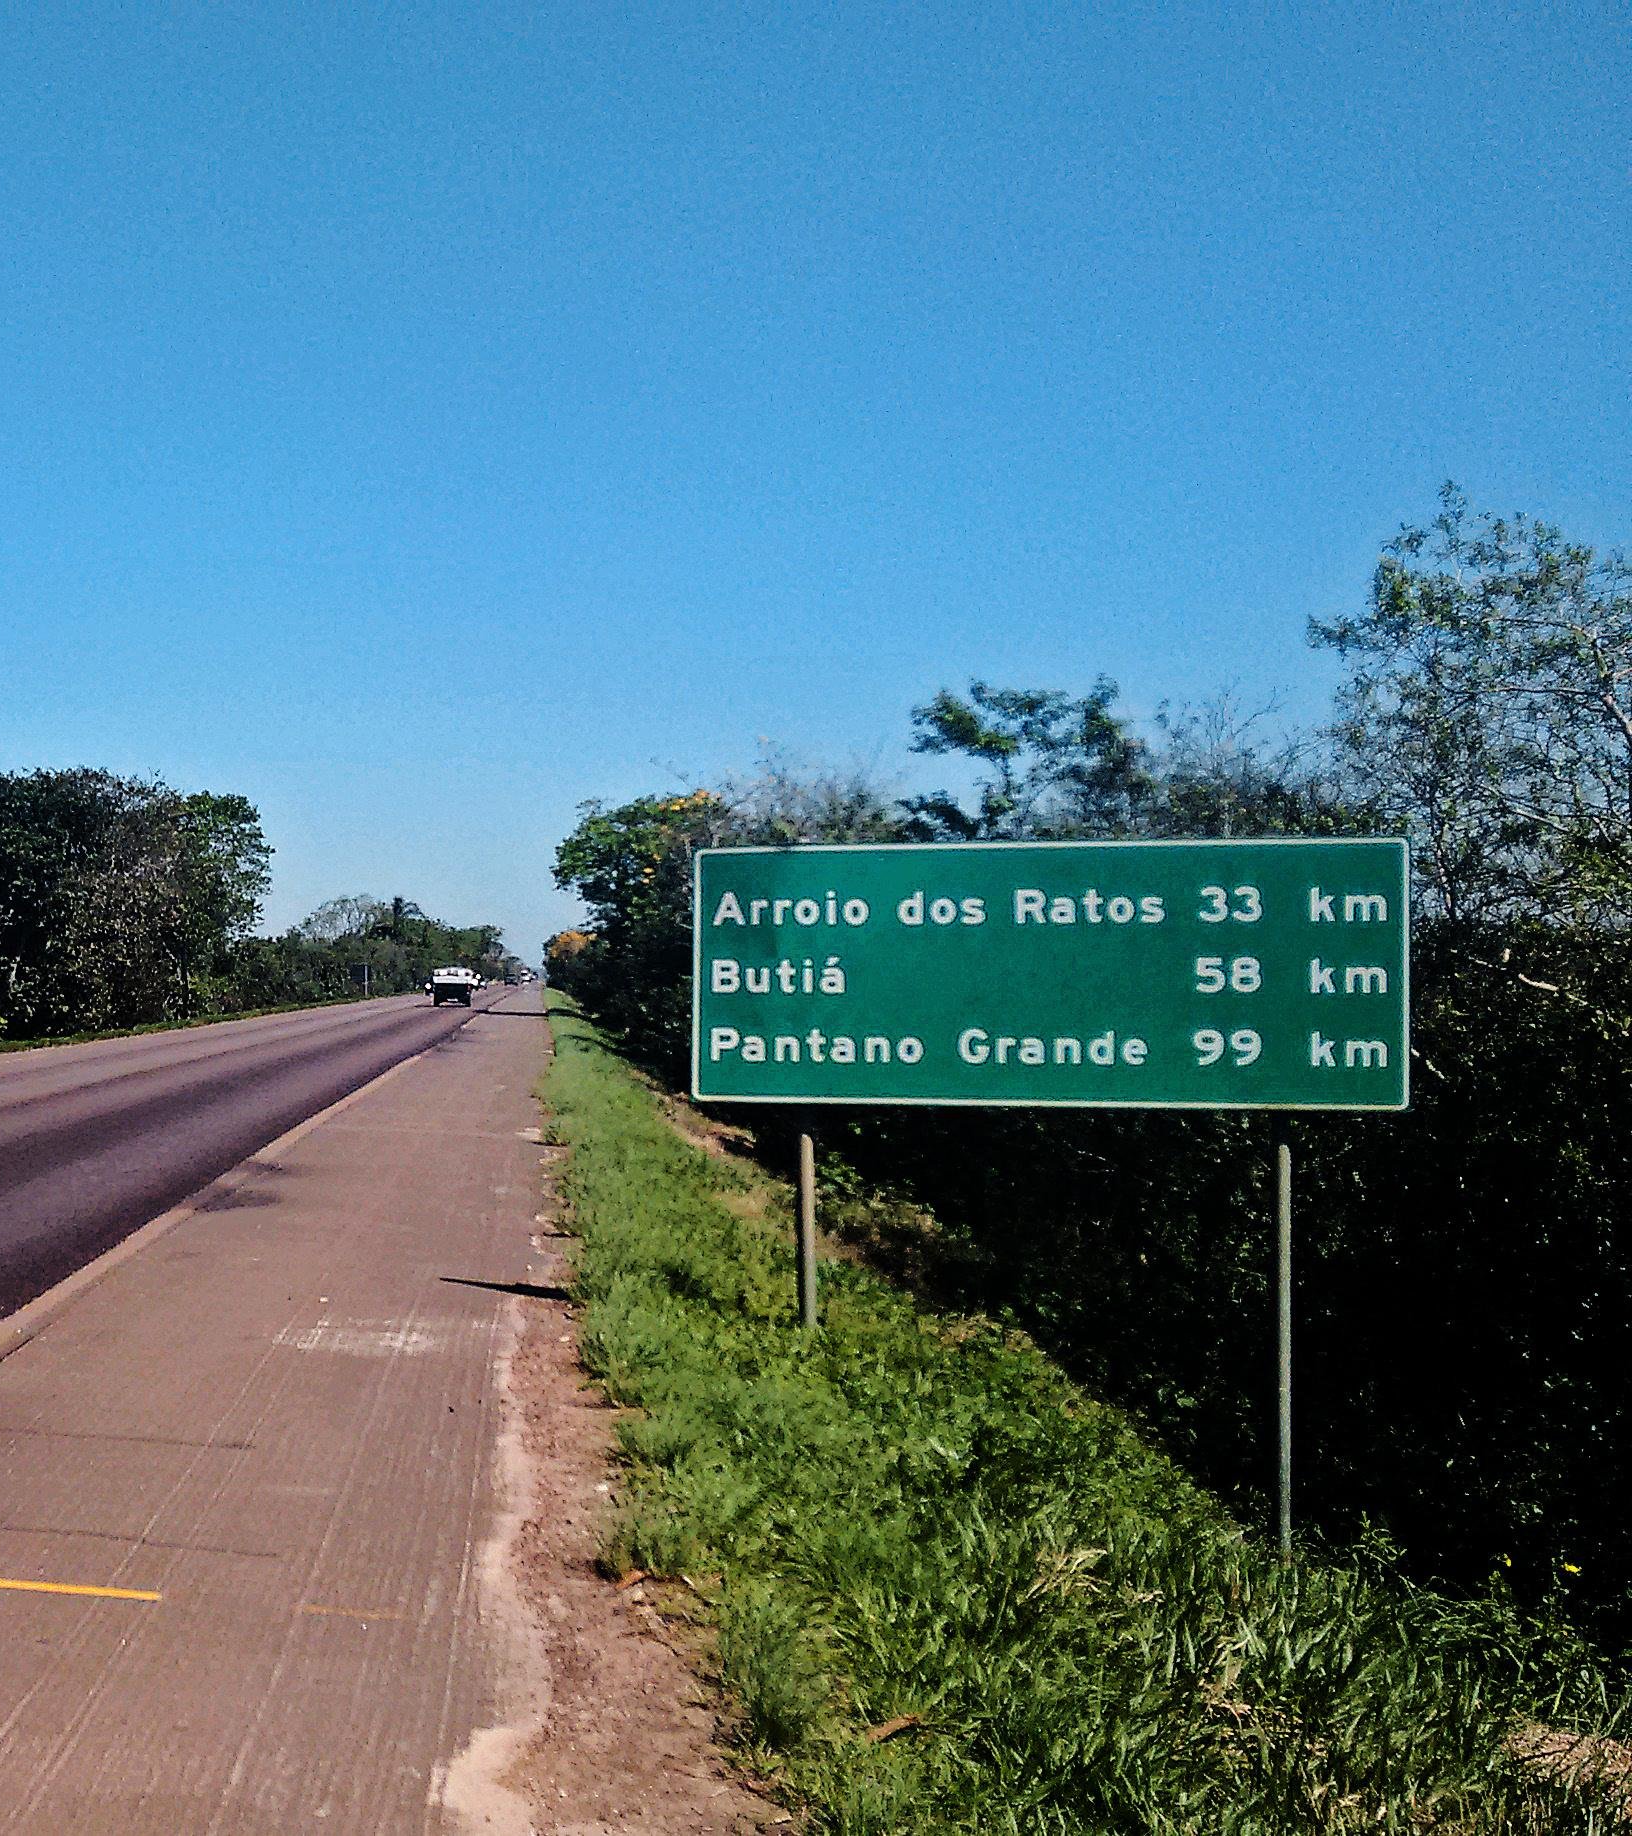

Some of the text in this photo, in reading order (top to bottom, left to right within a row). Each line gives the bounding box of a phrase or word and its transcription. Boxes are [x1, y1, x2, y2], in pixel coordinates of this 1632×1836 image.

[713, 886, 1387, 926] Arroio dos Ratos 33 km
[711, 956, 1387, 994] Butiá 58 km
[710, 1027, 1388, 1068] Pantano Grande 99 km
